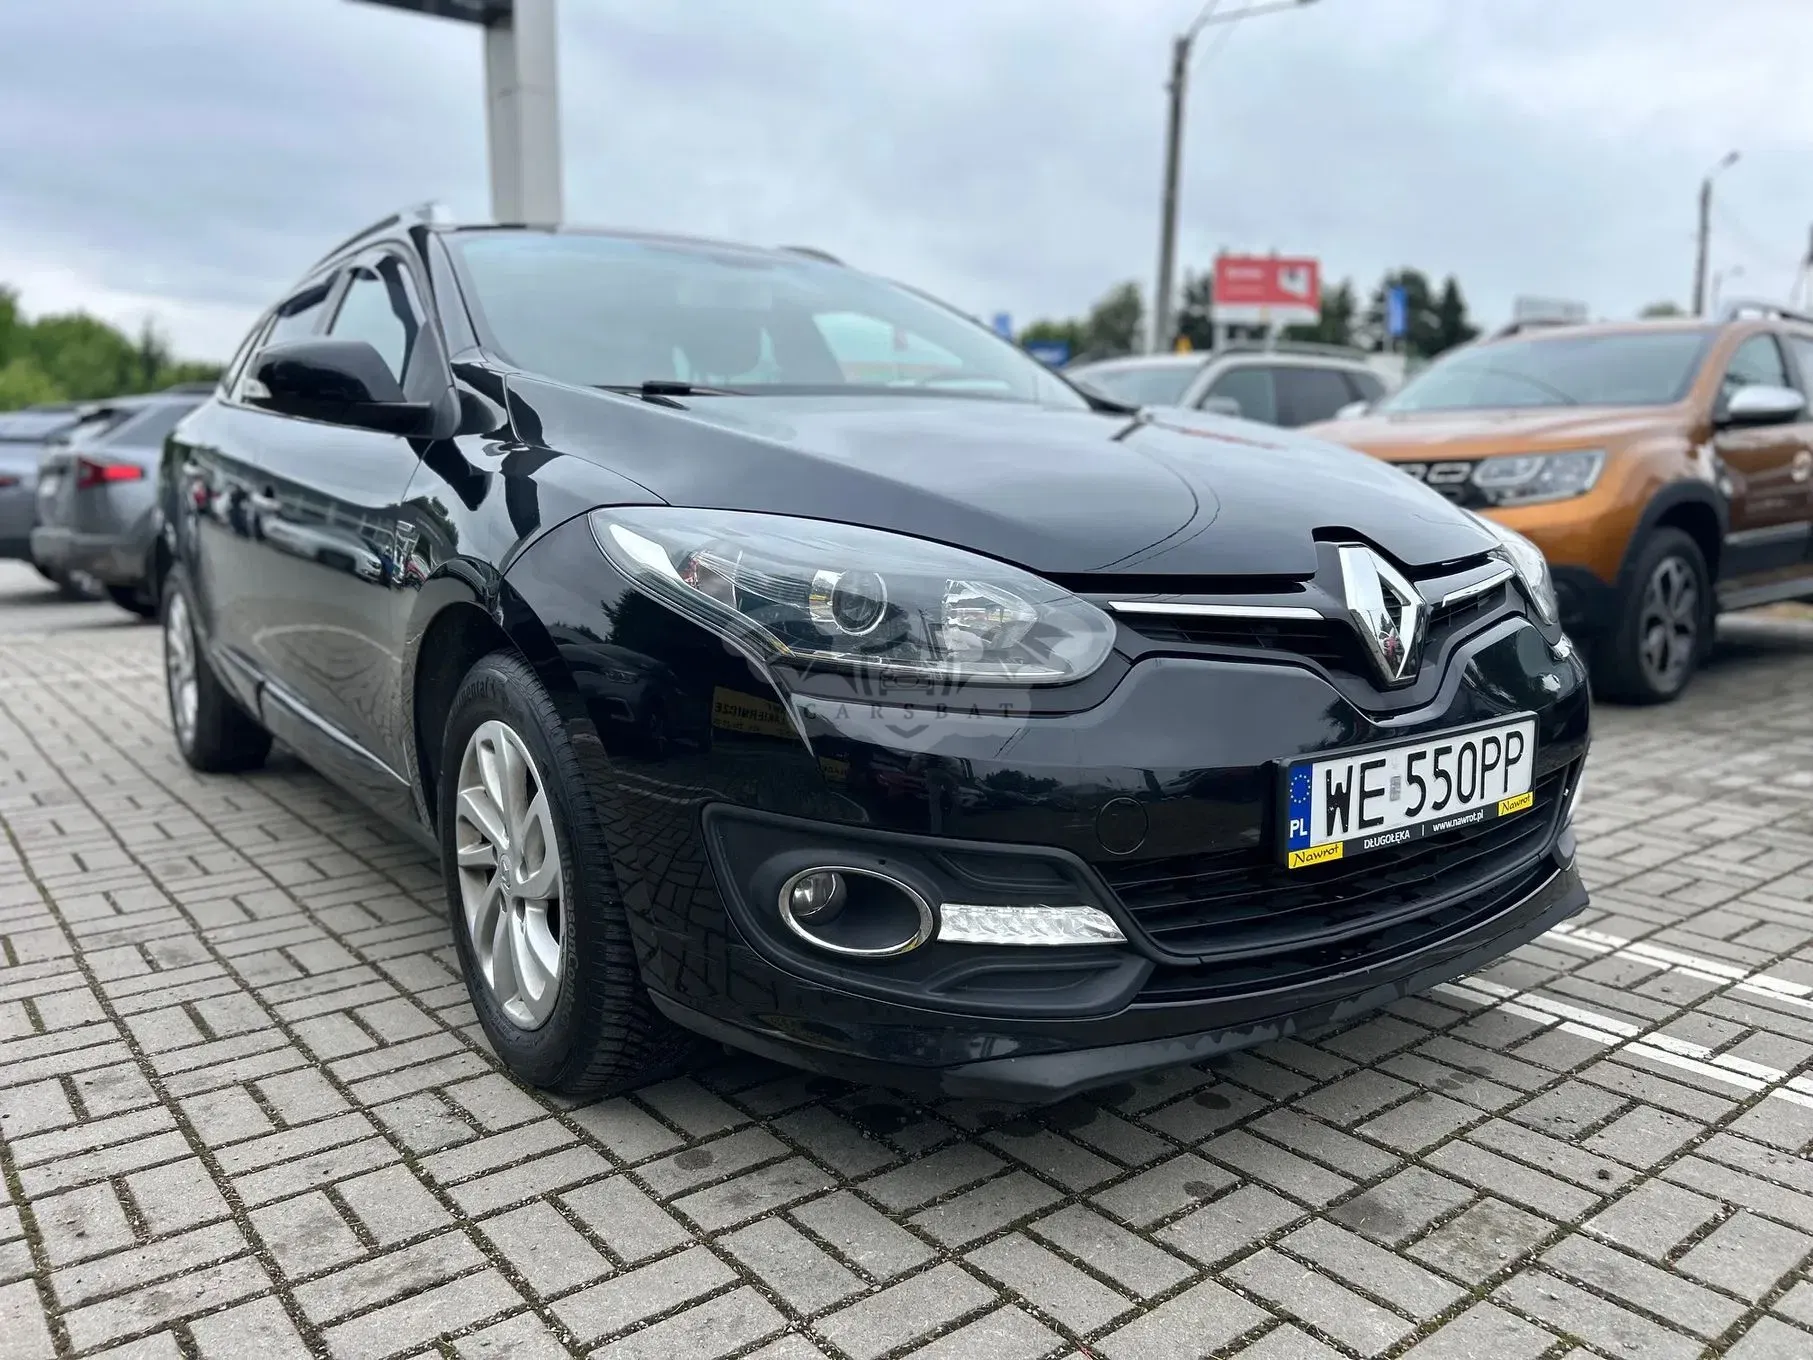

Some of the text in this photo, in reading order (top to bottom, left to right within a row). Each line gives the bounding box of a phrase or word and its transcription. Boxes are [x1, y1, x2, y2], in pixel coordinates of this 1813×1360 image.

[1325, 730, 1525, 838] WE 550PP
[1501, 794, 1531, 814] Nawrot
[1289, 818, 1308, 838] PL
[1363, 809, 1484, 849] DŁUGOŁĘKA www.nawrot.pl
[1292, 843, 1339, 868] Nawrot
